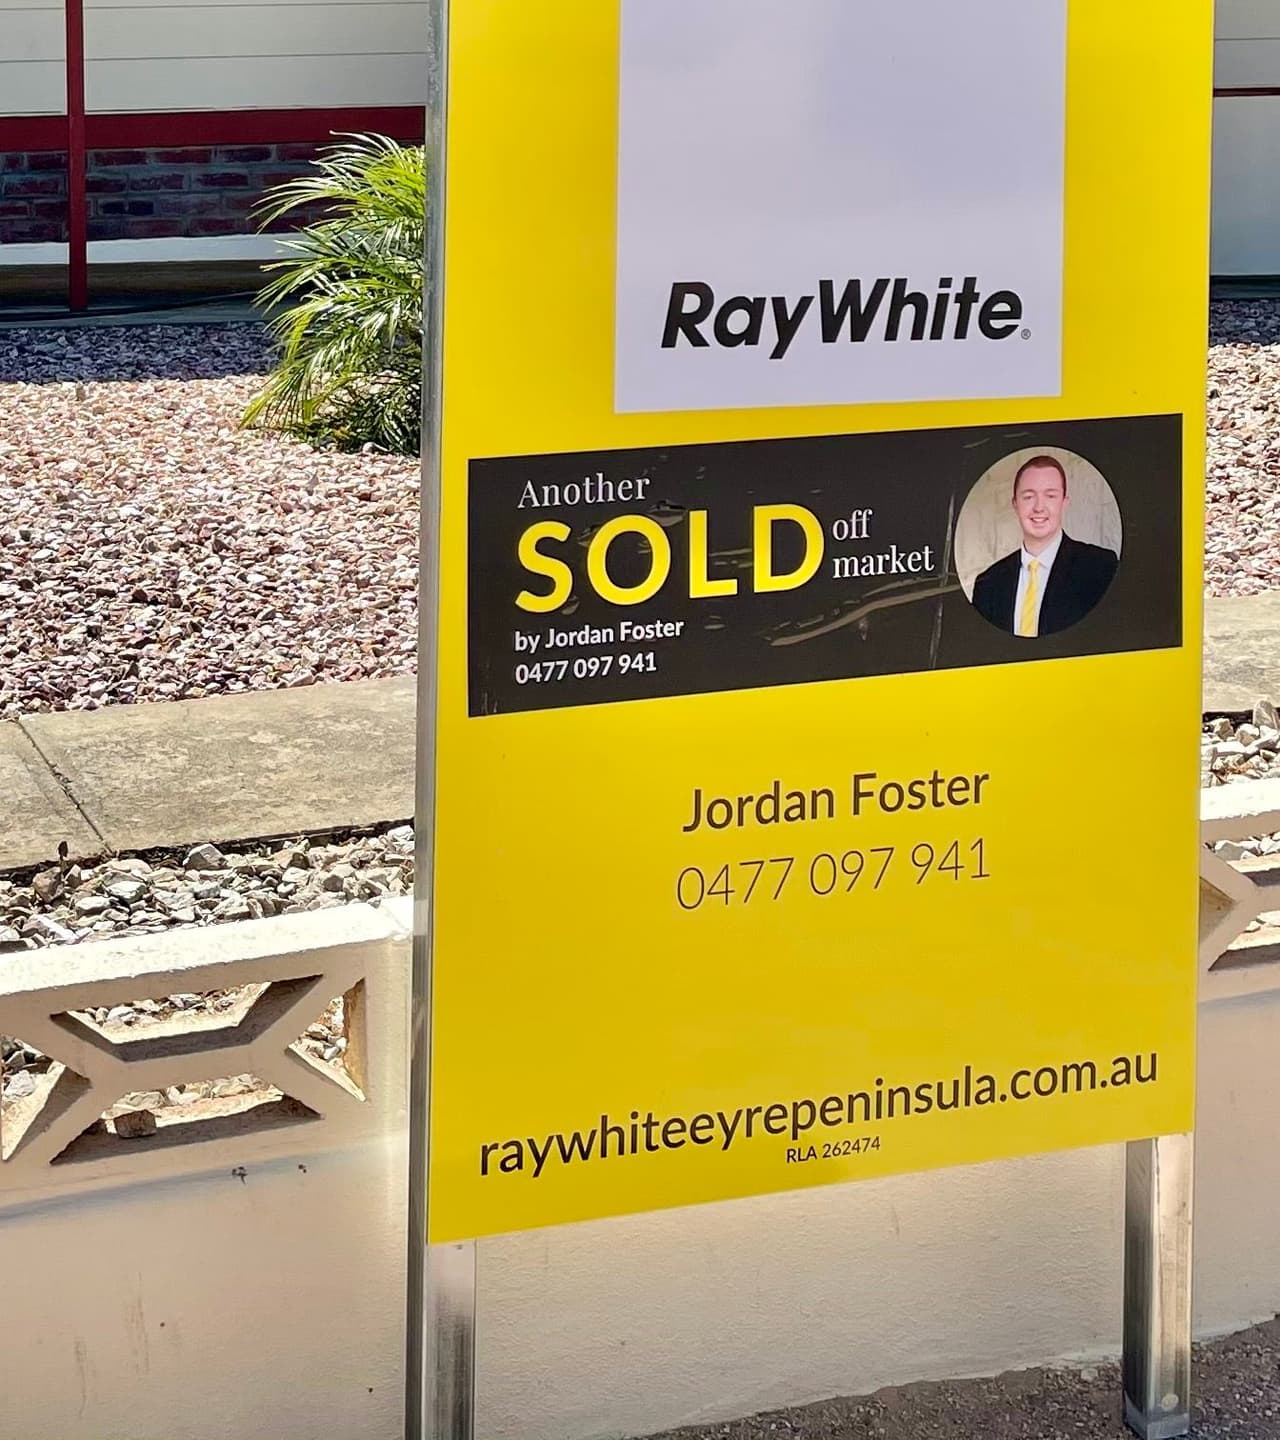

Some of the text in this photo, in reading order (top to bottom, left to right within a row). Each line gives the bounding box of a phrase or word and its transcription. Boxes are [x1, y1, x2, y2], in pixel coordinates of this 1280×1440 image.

[517, 474, 650, 509] Another
[832, 510, 872, 541] off
[514, 503, 826, 614] SOLD
[832, 544, 935, 580] market
[514, 618, 685, 653] by Jordan Foster
[514, 652, 658, 685] 0477 097 941
[682, 768, 991, 833] Jordan Foster
[677, 837, 991, 910] 0477 097 941
[479, 1052, 1159, 1177] raywhiteeyrepeninsula.com.au
[786, 1136, 881, 1164] RLA 262474
